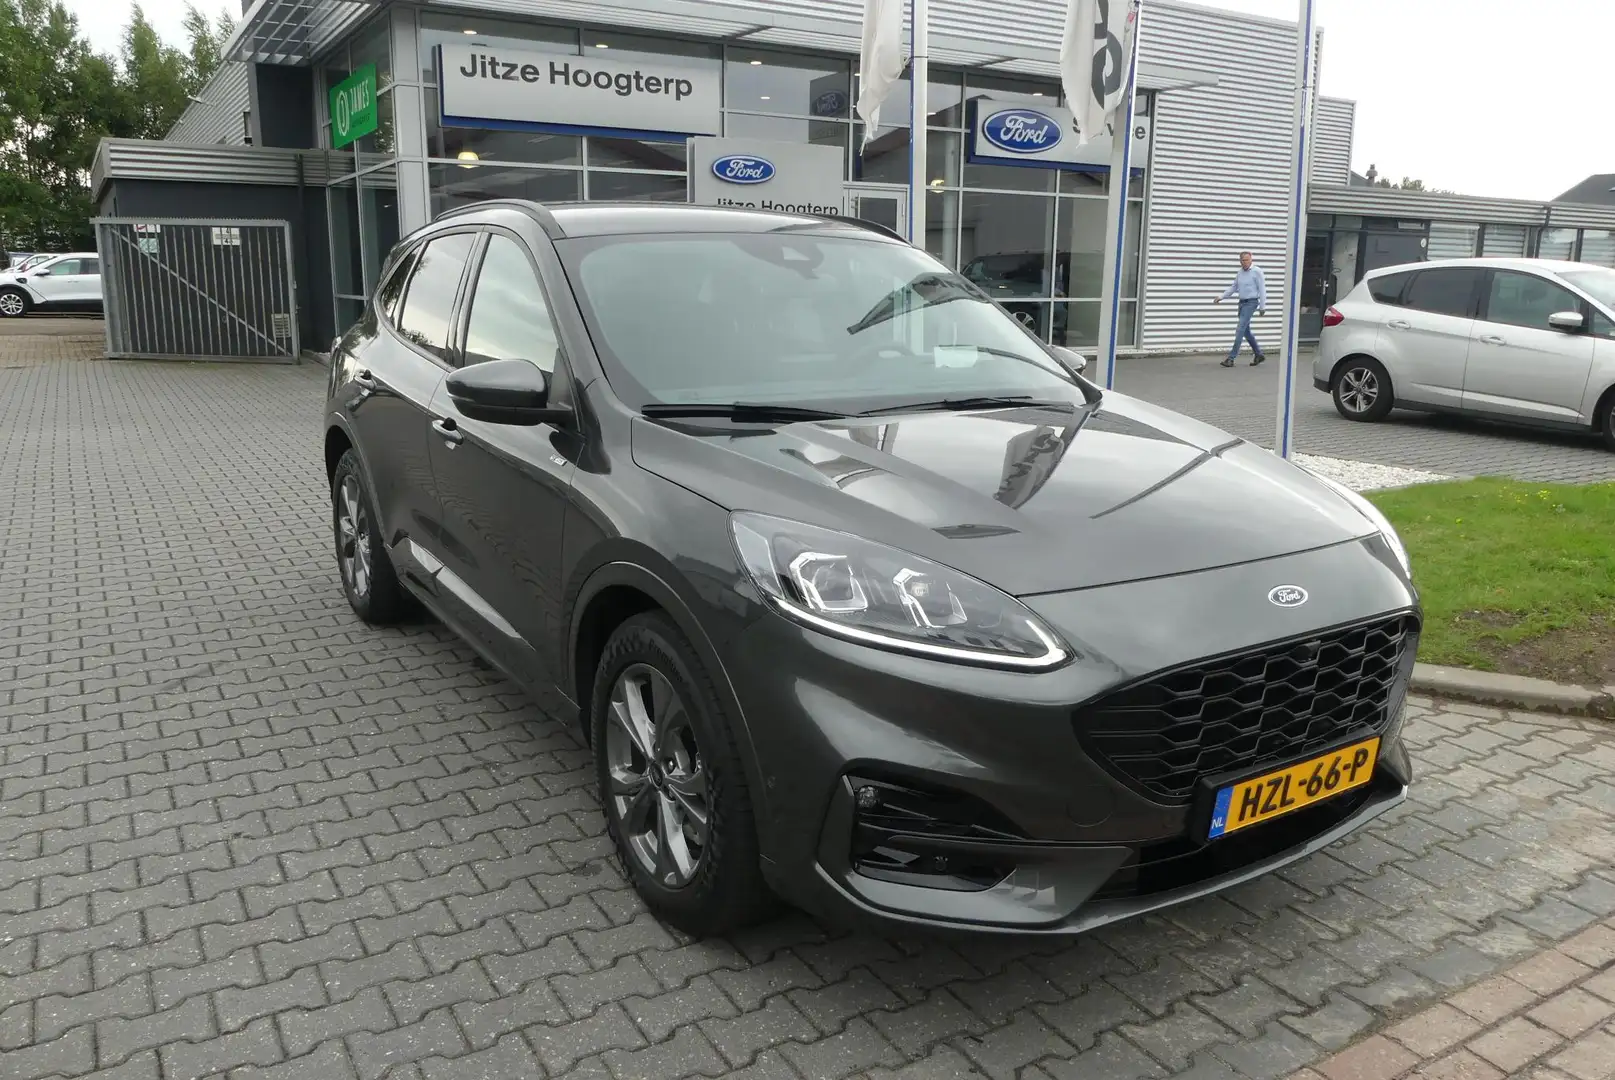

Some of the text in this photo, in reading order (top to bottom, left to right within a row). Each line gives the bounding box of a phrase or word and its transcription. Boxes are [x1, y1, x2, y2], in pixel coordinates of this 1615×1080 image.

[459, 53, 693, 101] Jitze Hoogterp
[350, 79, 370, 116] JAMES
[1000, 115, 1049, 144] Ford
[726, 159, 764, 179] Ford
[1277, 588, 1301, 603] Ford
[1238, 747, 1369, 822] HZL-66-P
[1211, 817, 1224, 829] NL
